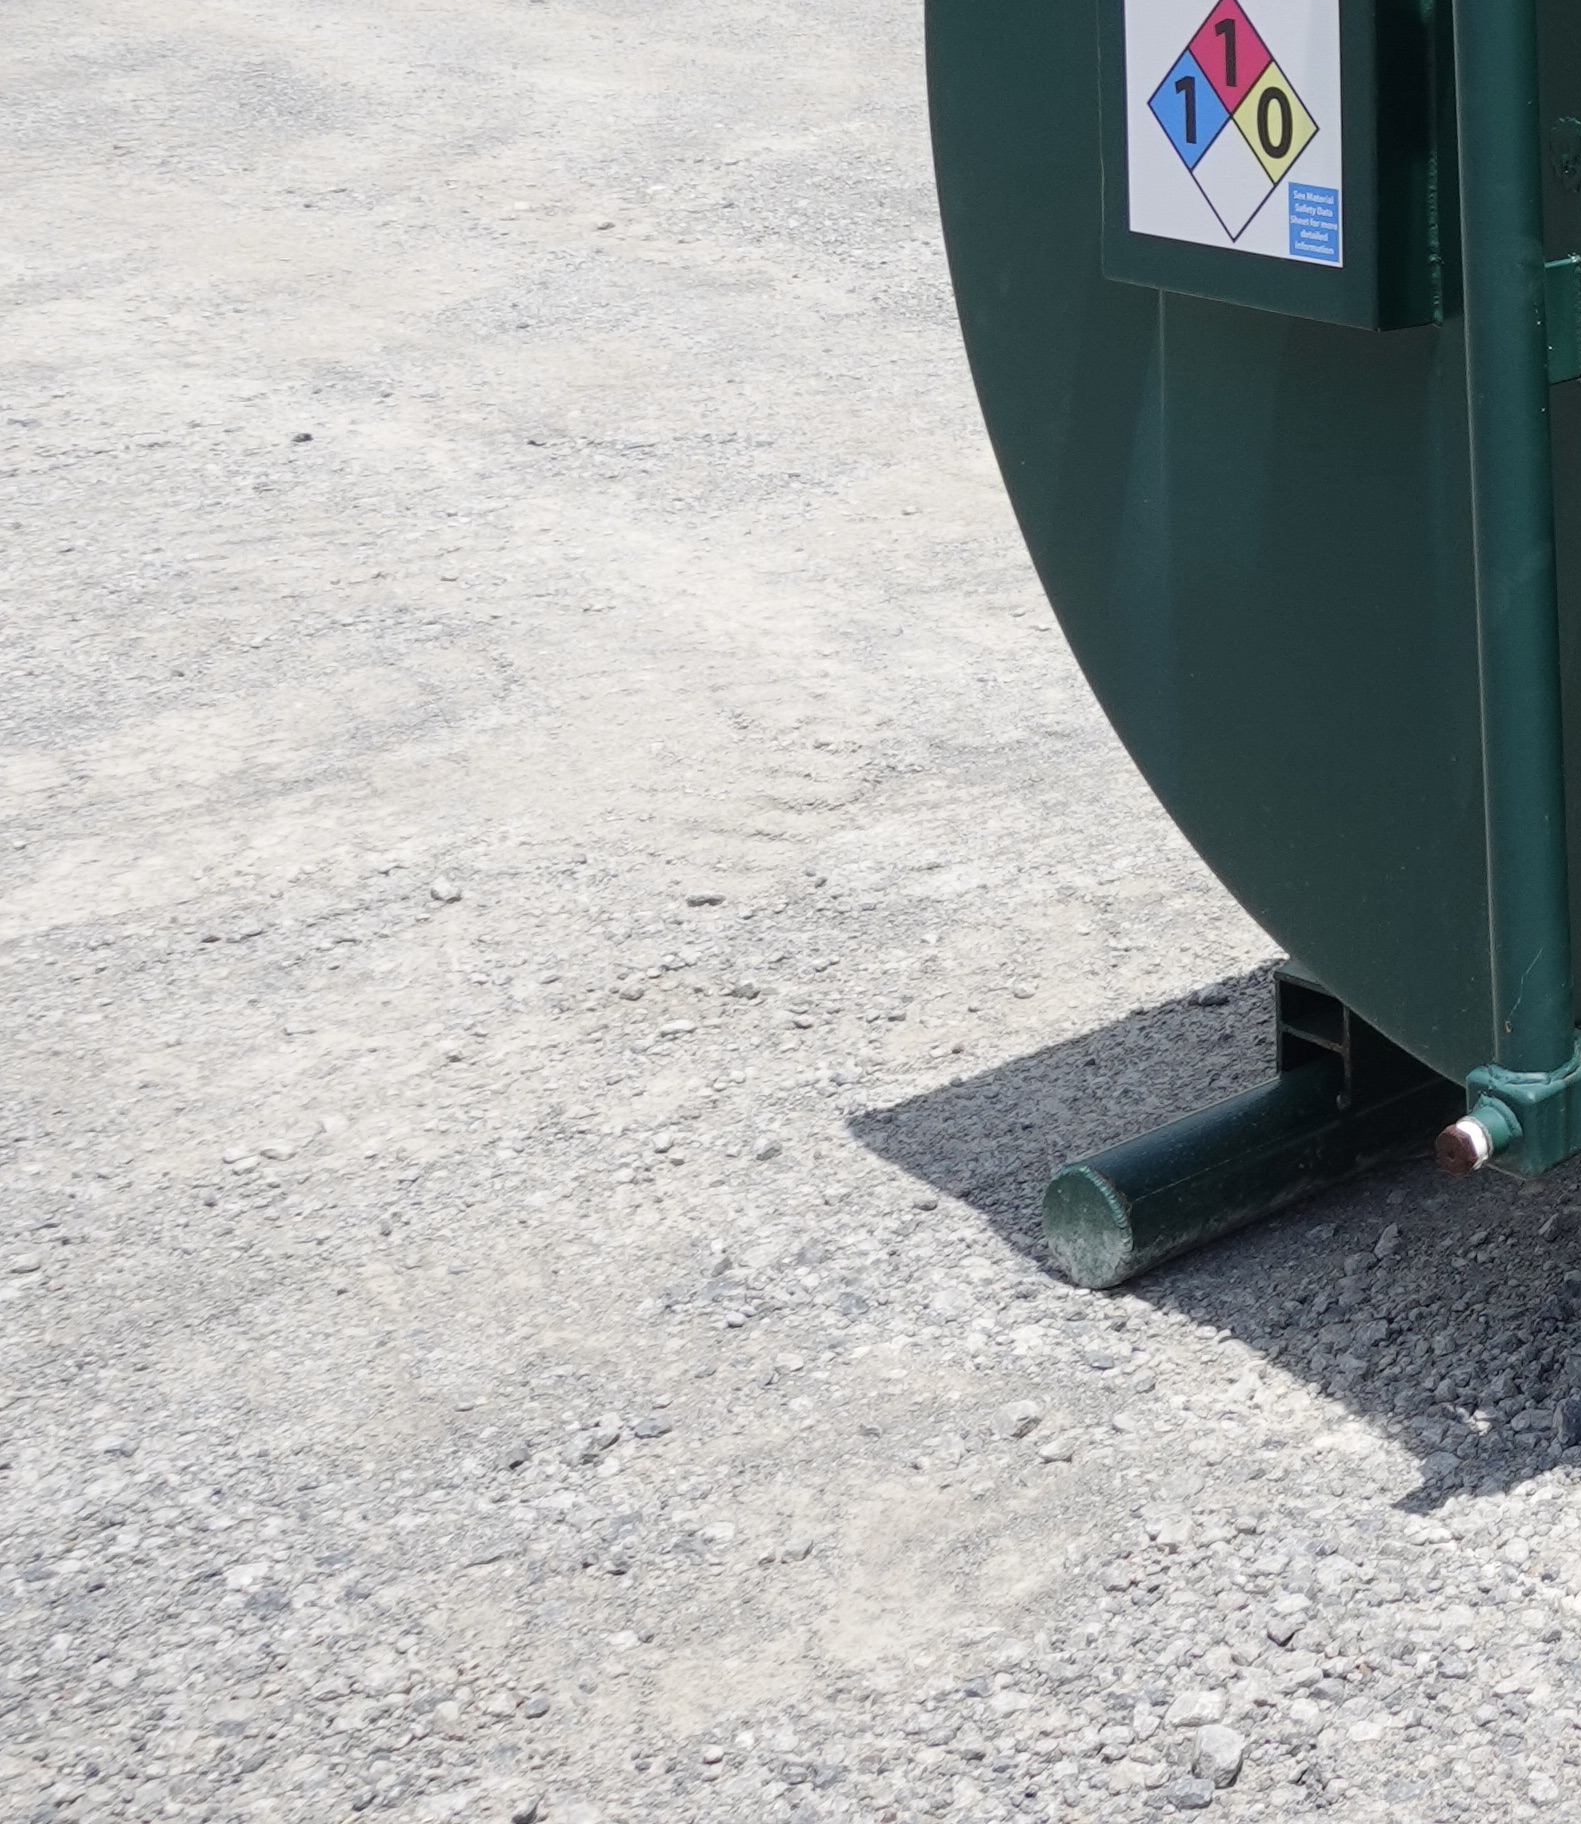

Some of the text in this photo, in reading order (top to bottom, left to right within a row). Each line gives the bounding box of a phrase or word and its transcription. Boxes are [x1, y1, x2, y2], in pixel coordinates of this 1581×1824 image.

[1213, 17, 1238, 88] 1
[1174, 75, 1197, 145] 1
[1256, 85, 1293, 159] 0
[1294, 203, 1333, 217] Safety Data
[1306, 192, 1334, 204] Material
